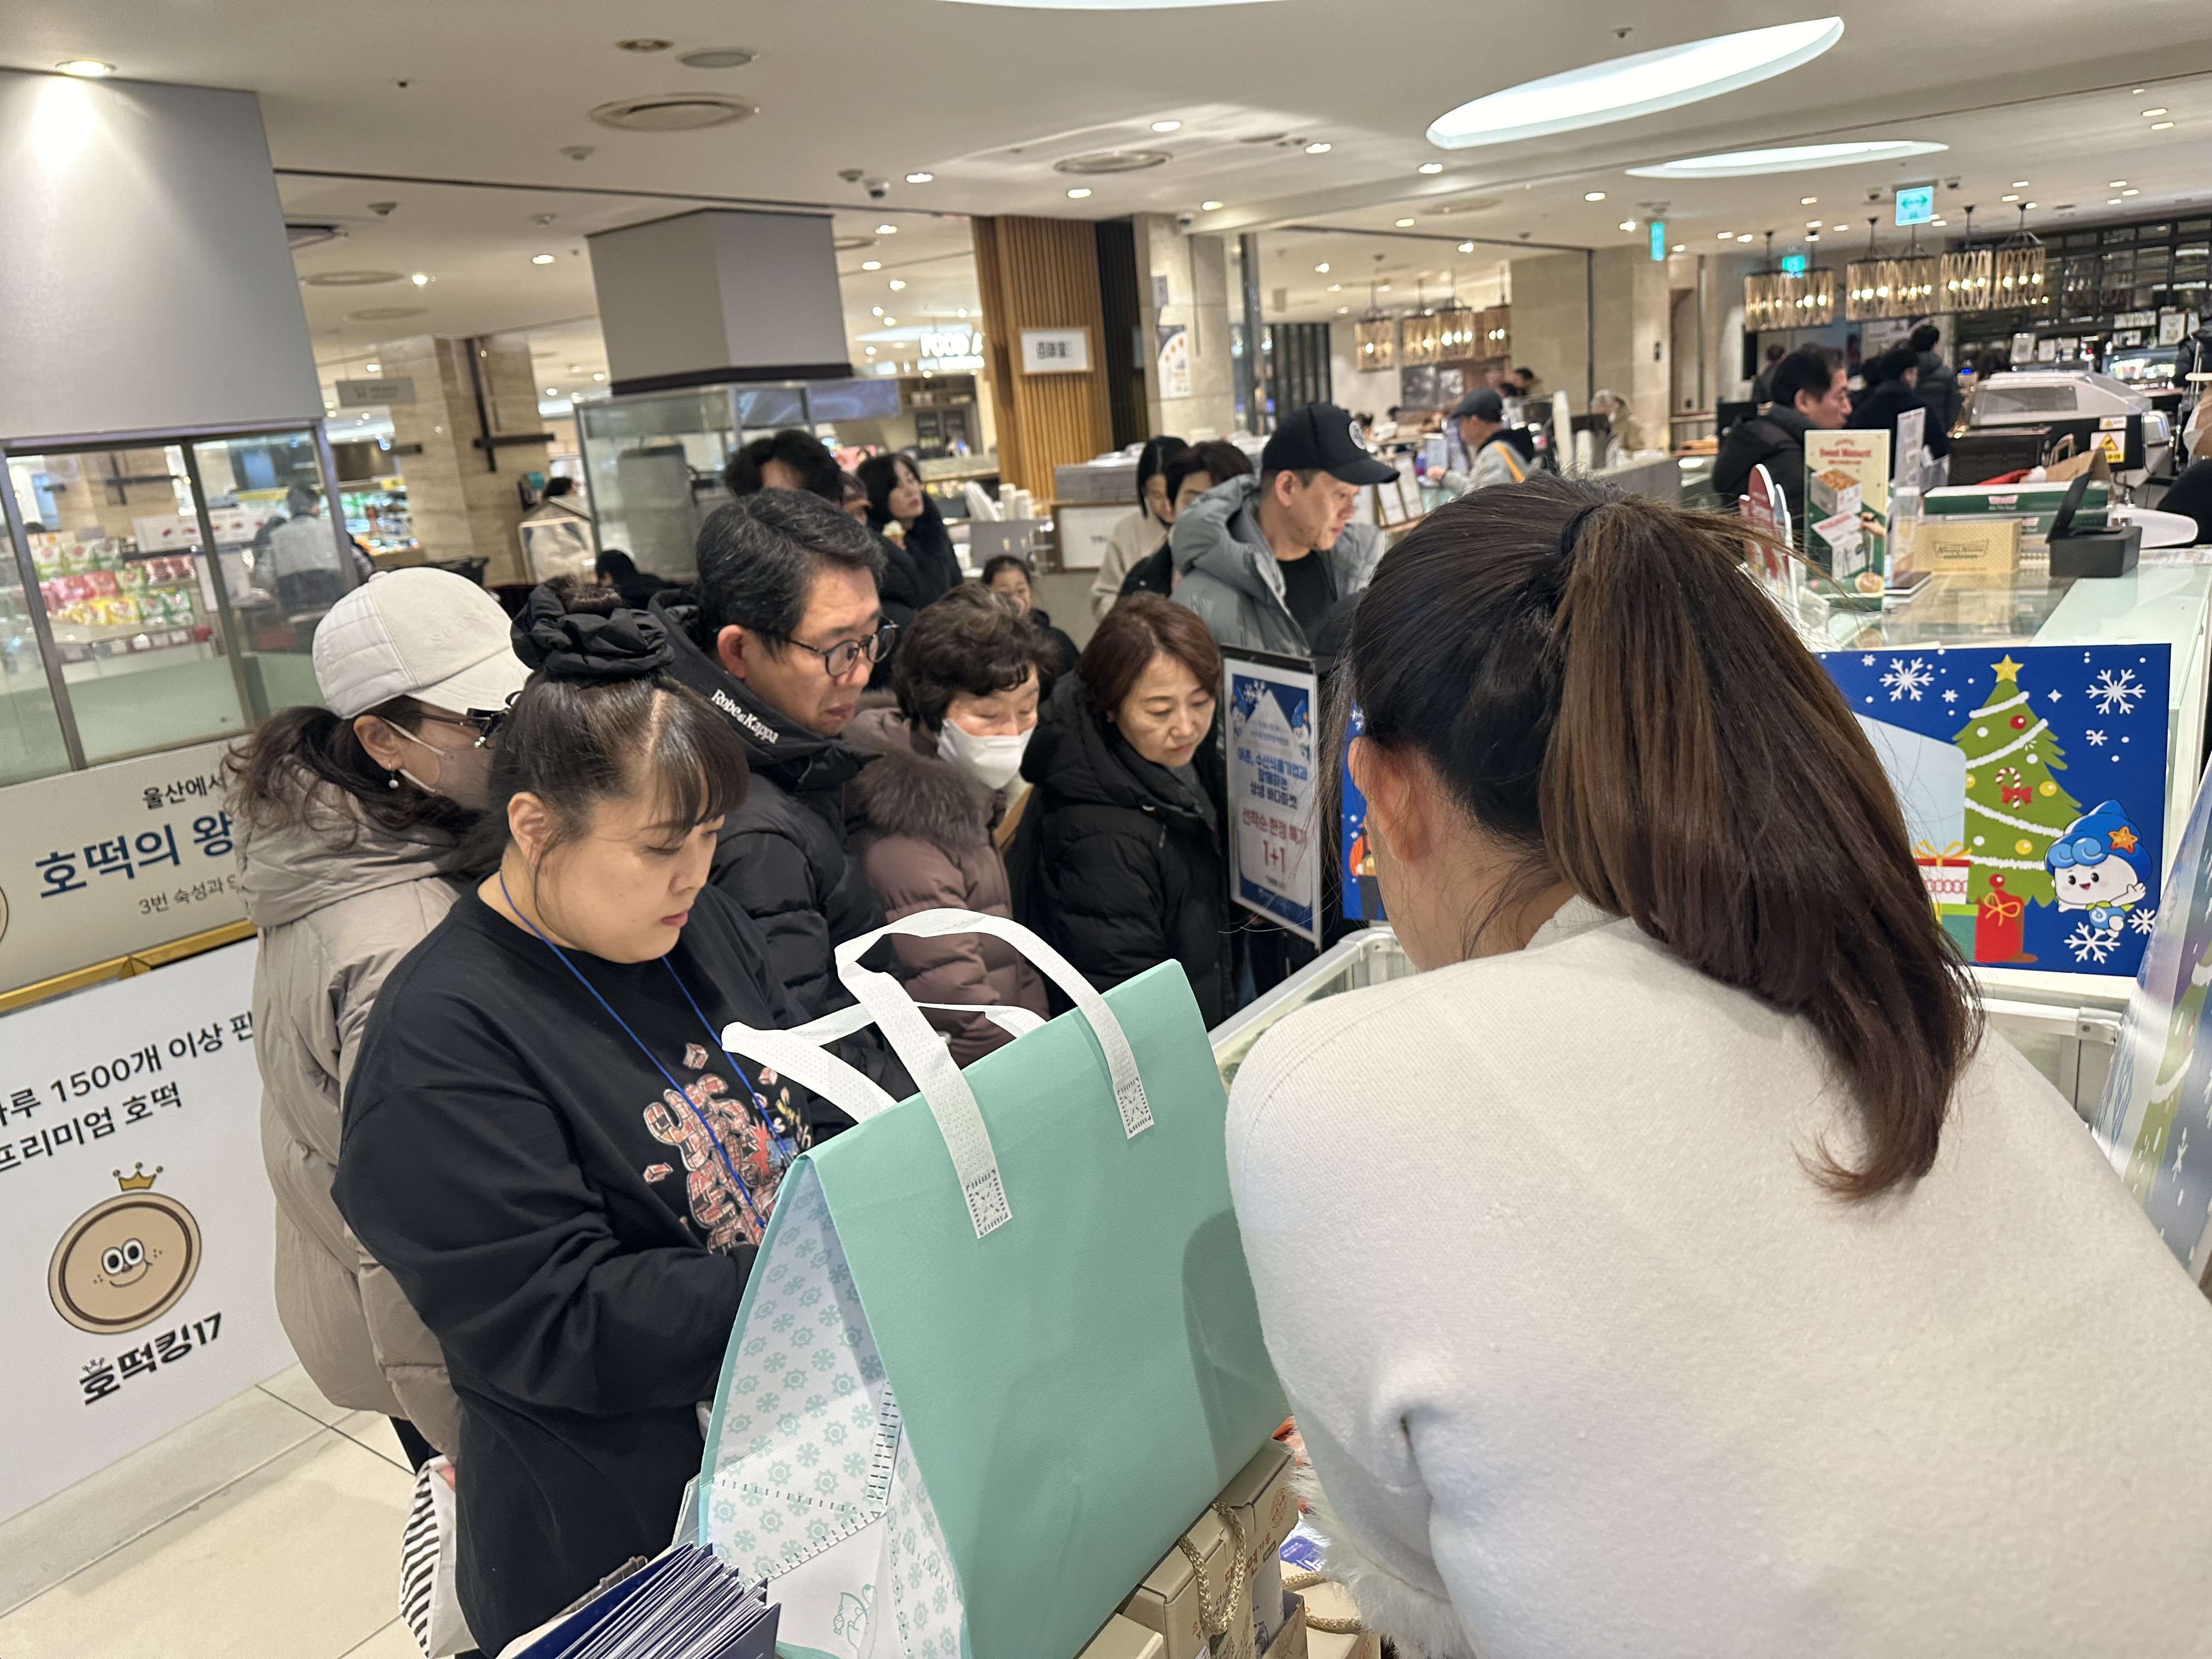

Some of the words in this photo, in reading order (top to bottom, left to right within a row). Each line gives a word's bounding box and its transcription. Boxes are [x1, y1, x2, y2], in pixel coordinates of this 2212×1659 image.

[711, 688, 741, 717] Robe
[742, 713, 779, 744] Kappa
[35, 822, 181, 898] 호떡의
[192, 810, 233, 856] 왕
[1263, 839, 1285, 874] 1+1
[139, 892, 170, 915] 3번
[173, 876, 224, 905] 숙성과
[50, 1043, 162, 1103] 1500개
[168, 1022, 224, 1059] 이상
[0, 1105, 115, 1172] 프리미엄
[122, 1080, 182, 1125] 호떡
[79, 1310, 222, 1406] 호떡킹17
